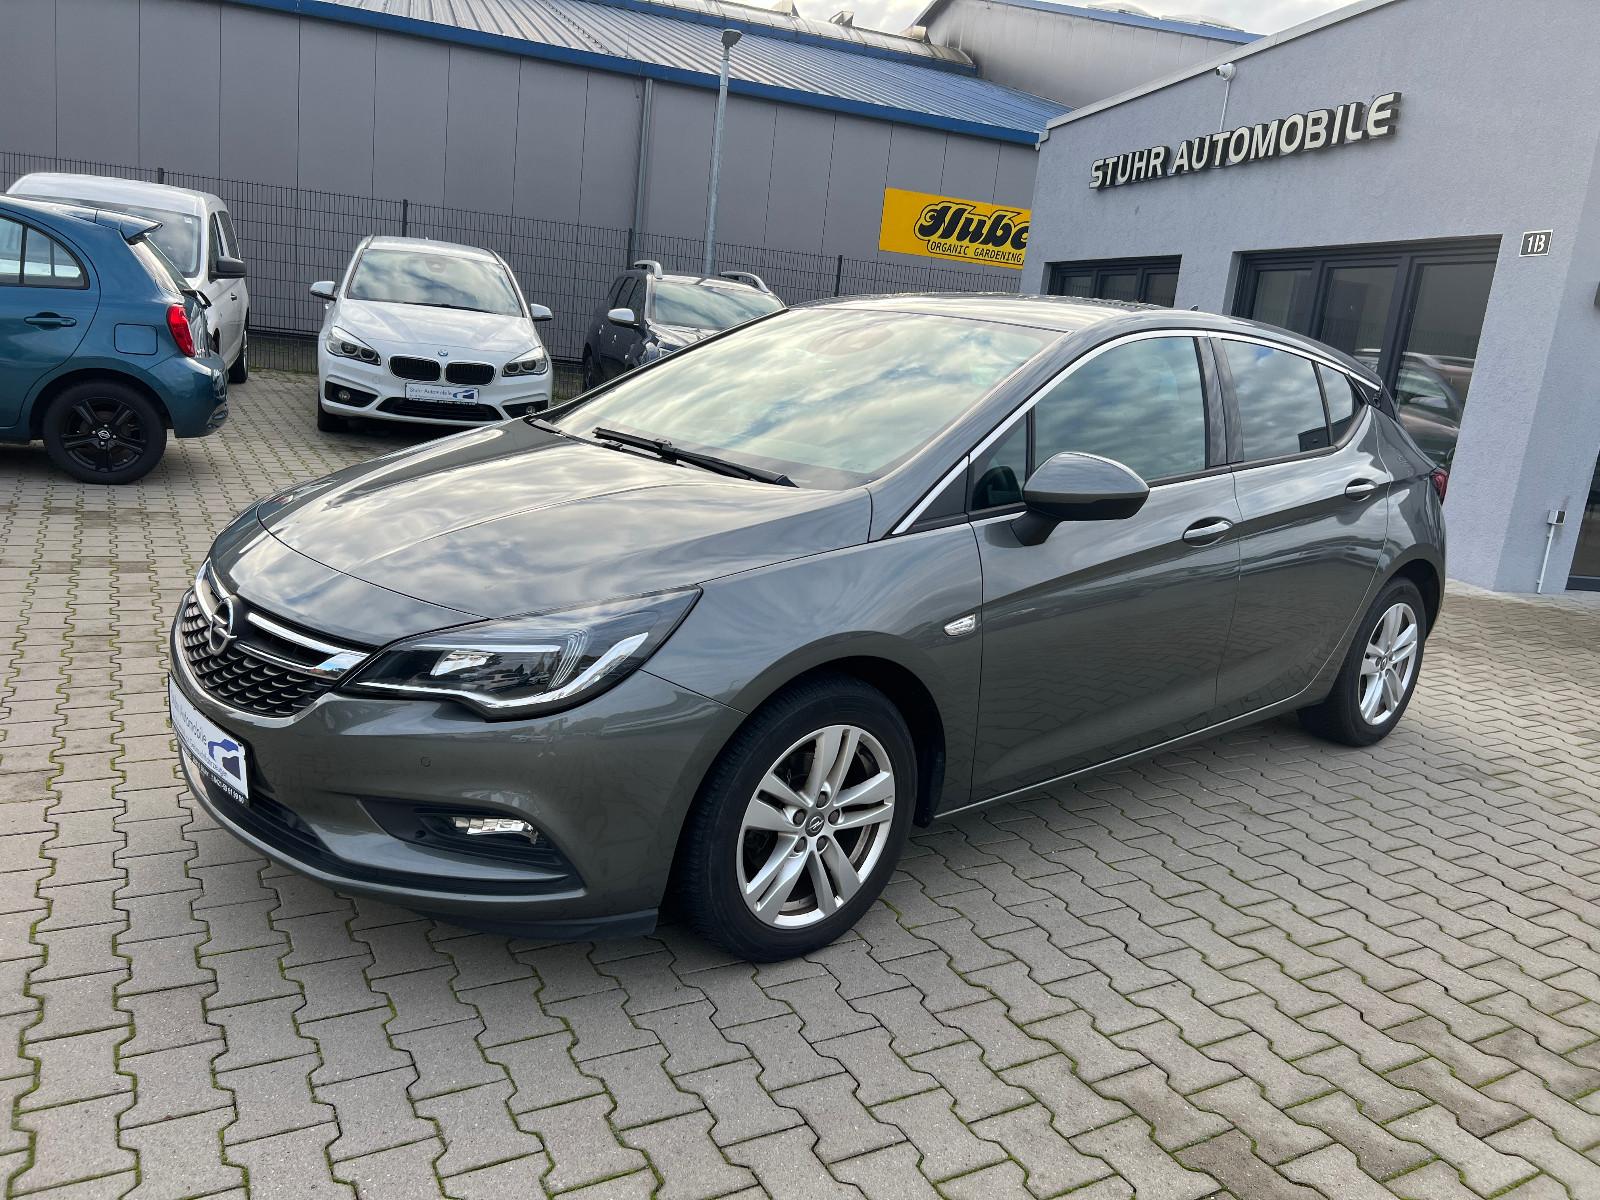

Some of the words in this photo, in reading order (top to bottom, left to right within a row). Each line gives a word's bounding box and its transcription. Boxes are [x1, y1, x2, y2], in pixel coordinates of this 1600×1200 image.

[1089, 146, 1168, 189] STUHR
[1171, 92, 1399, 175] AUTOMOBILE
[930, 241, 969, 256] ORGANIC
[973, 247, 1023, 263] GARDENING
[1527, 234, 1546, 253] 1B
